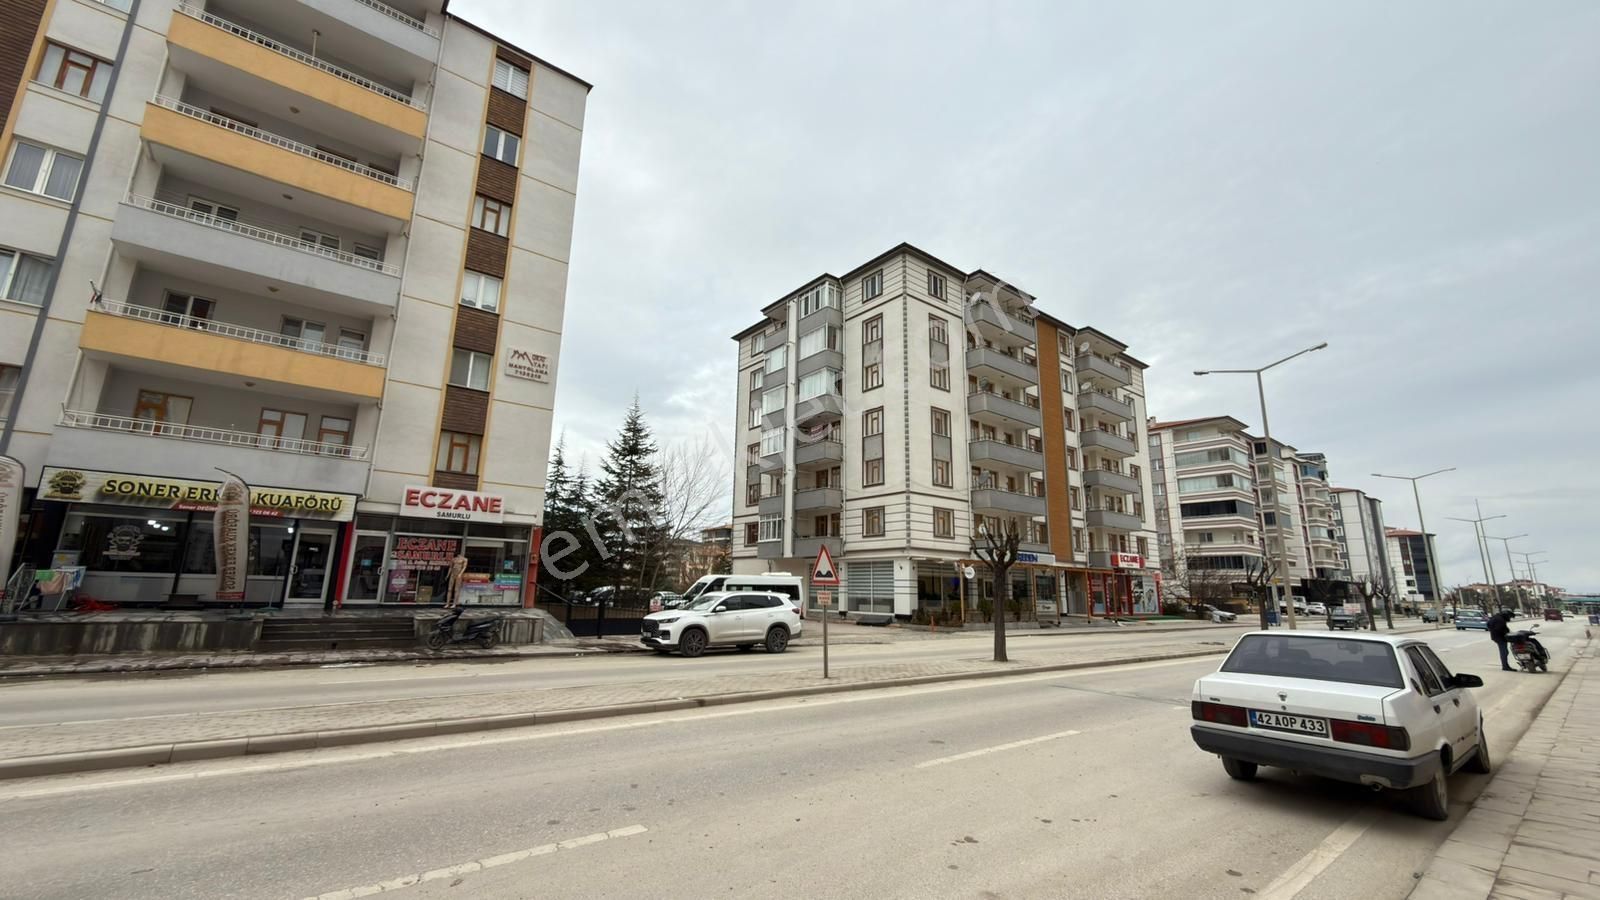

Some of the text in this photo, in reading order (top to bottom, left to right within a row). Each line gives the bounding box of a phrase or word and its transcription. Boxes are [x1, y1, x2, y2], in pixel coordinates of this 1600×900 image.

[508, 362, 549, 375] MANTOLAMA
[103, 479, 343, 512] SONER ERK KUAFÖRÜ
[405, 488, 503, 513] ECZANE
[436, 511, 471, 520] SAMURLU
[397, 536, 457, 551] ECZANE
[1257, 712, 1272, 724] 42
[1299, 718, 1325, 732] 433
